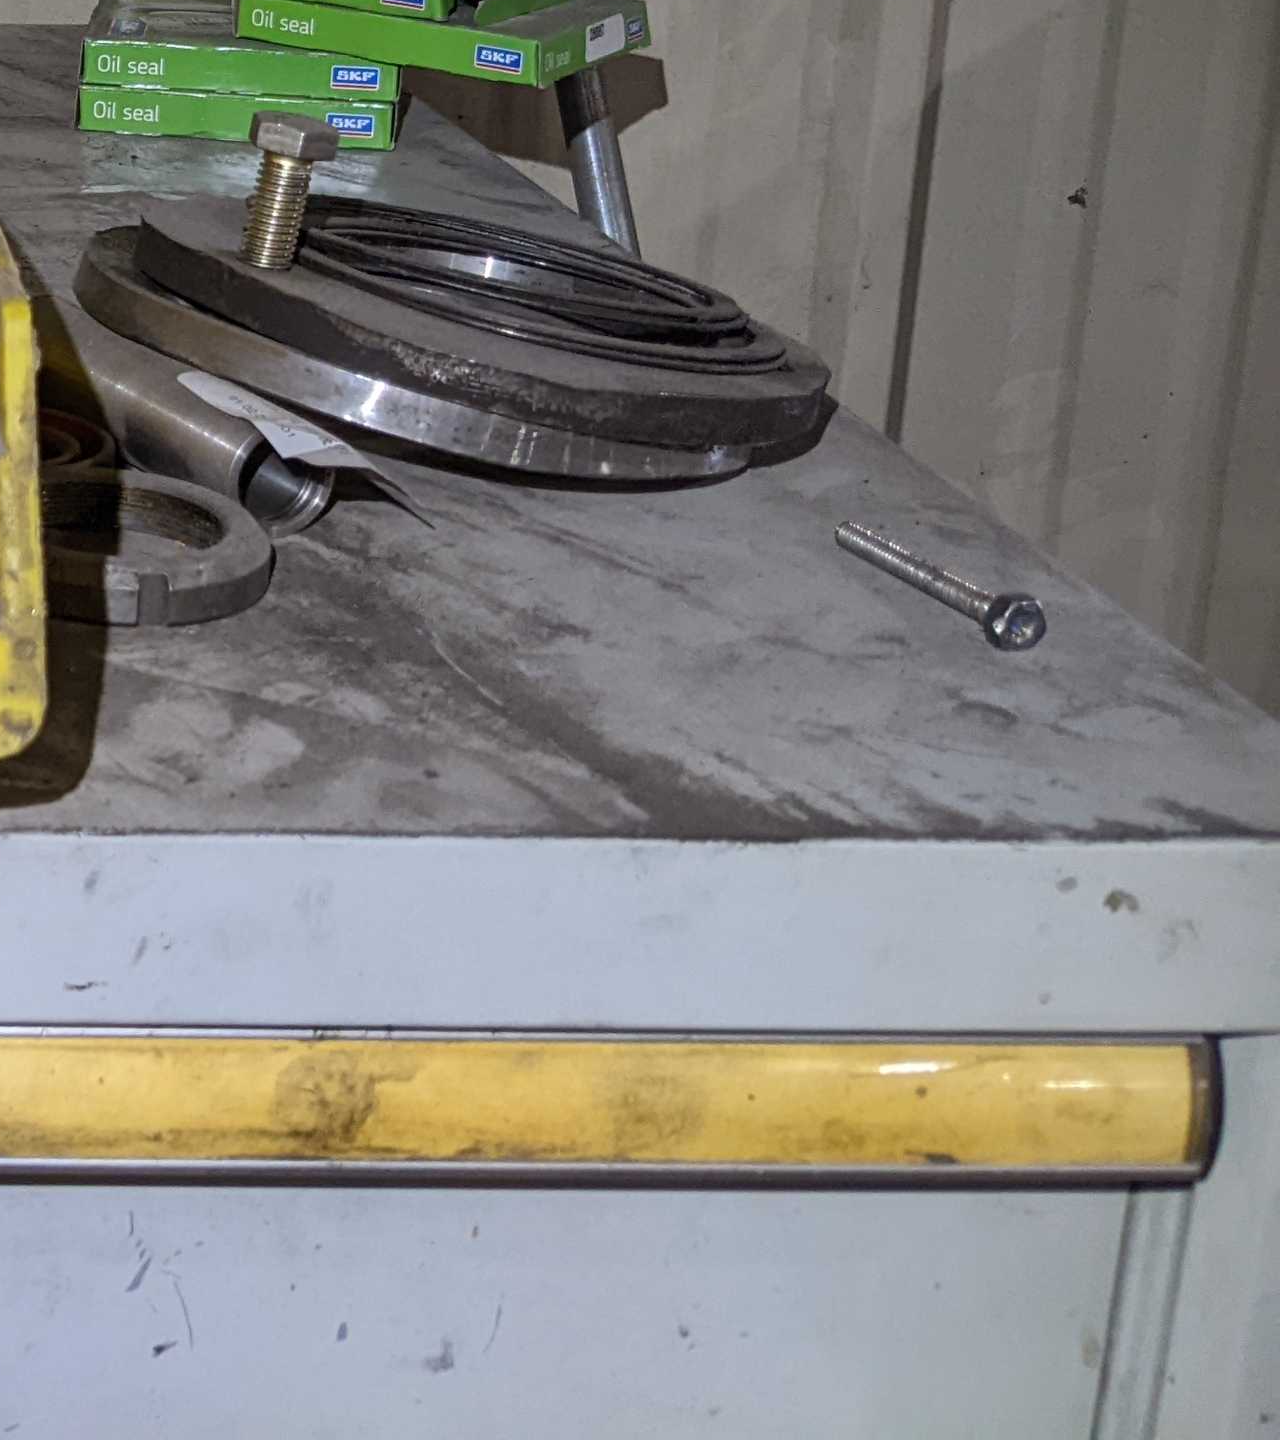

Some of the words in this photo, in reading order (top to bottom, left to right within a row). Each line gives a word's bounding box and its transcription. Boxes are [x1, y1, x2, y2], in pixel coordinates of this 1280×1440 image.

[251, 8, 273, 28] Oil
[279, 18, 314, 36] seal
[97, 54, 120, 73] Oil
[127, 57, 164, 75] seal
[480, 48, 518, 64] SKF
[336, 70, 375, 81] SKF
[93, 101, 116, 119] Oil
[123, 104, 159, 122] seal
[332, 117, 370, 129] SKF
